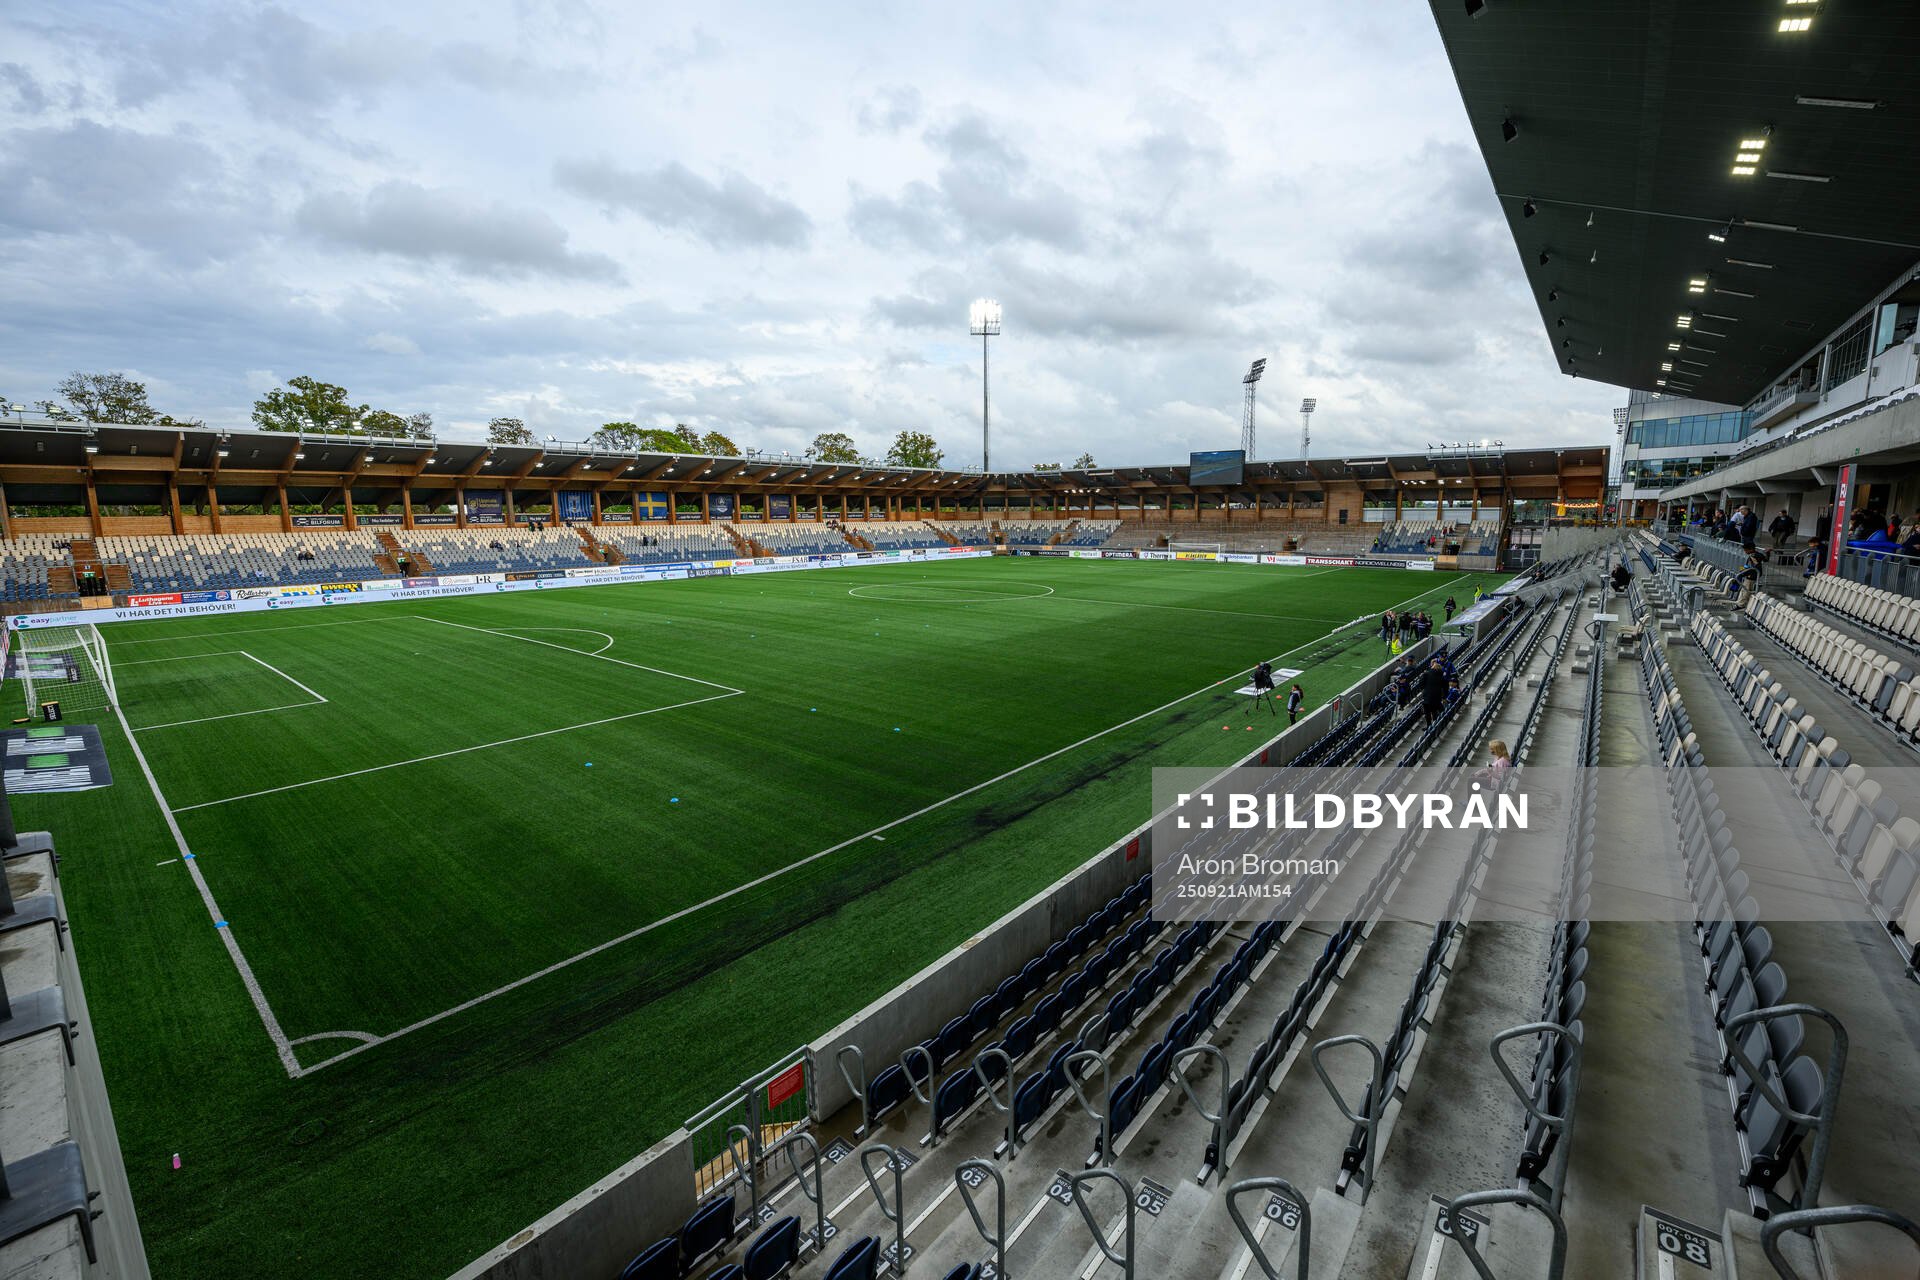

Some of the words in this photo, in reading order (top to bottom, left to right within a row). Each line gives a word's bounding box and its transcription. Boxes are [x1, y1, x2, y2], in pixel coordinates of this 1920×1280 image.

[189, 603, 236, 612] BEHÖVER!
[961, 1170, 982, 1186] 03
[1050, 1184, 1072, 1205] 04
[1136, 1194, 1164, 1215] 05
[1267, 1204, 1298, 1228] 06
[1272, 1197, 1300, 1214] 007-043
[1658, 1223, 1708, 1247] 007-043
[1660, 1232, 1708, 1264] 08
